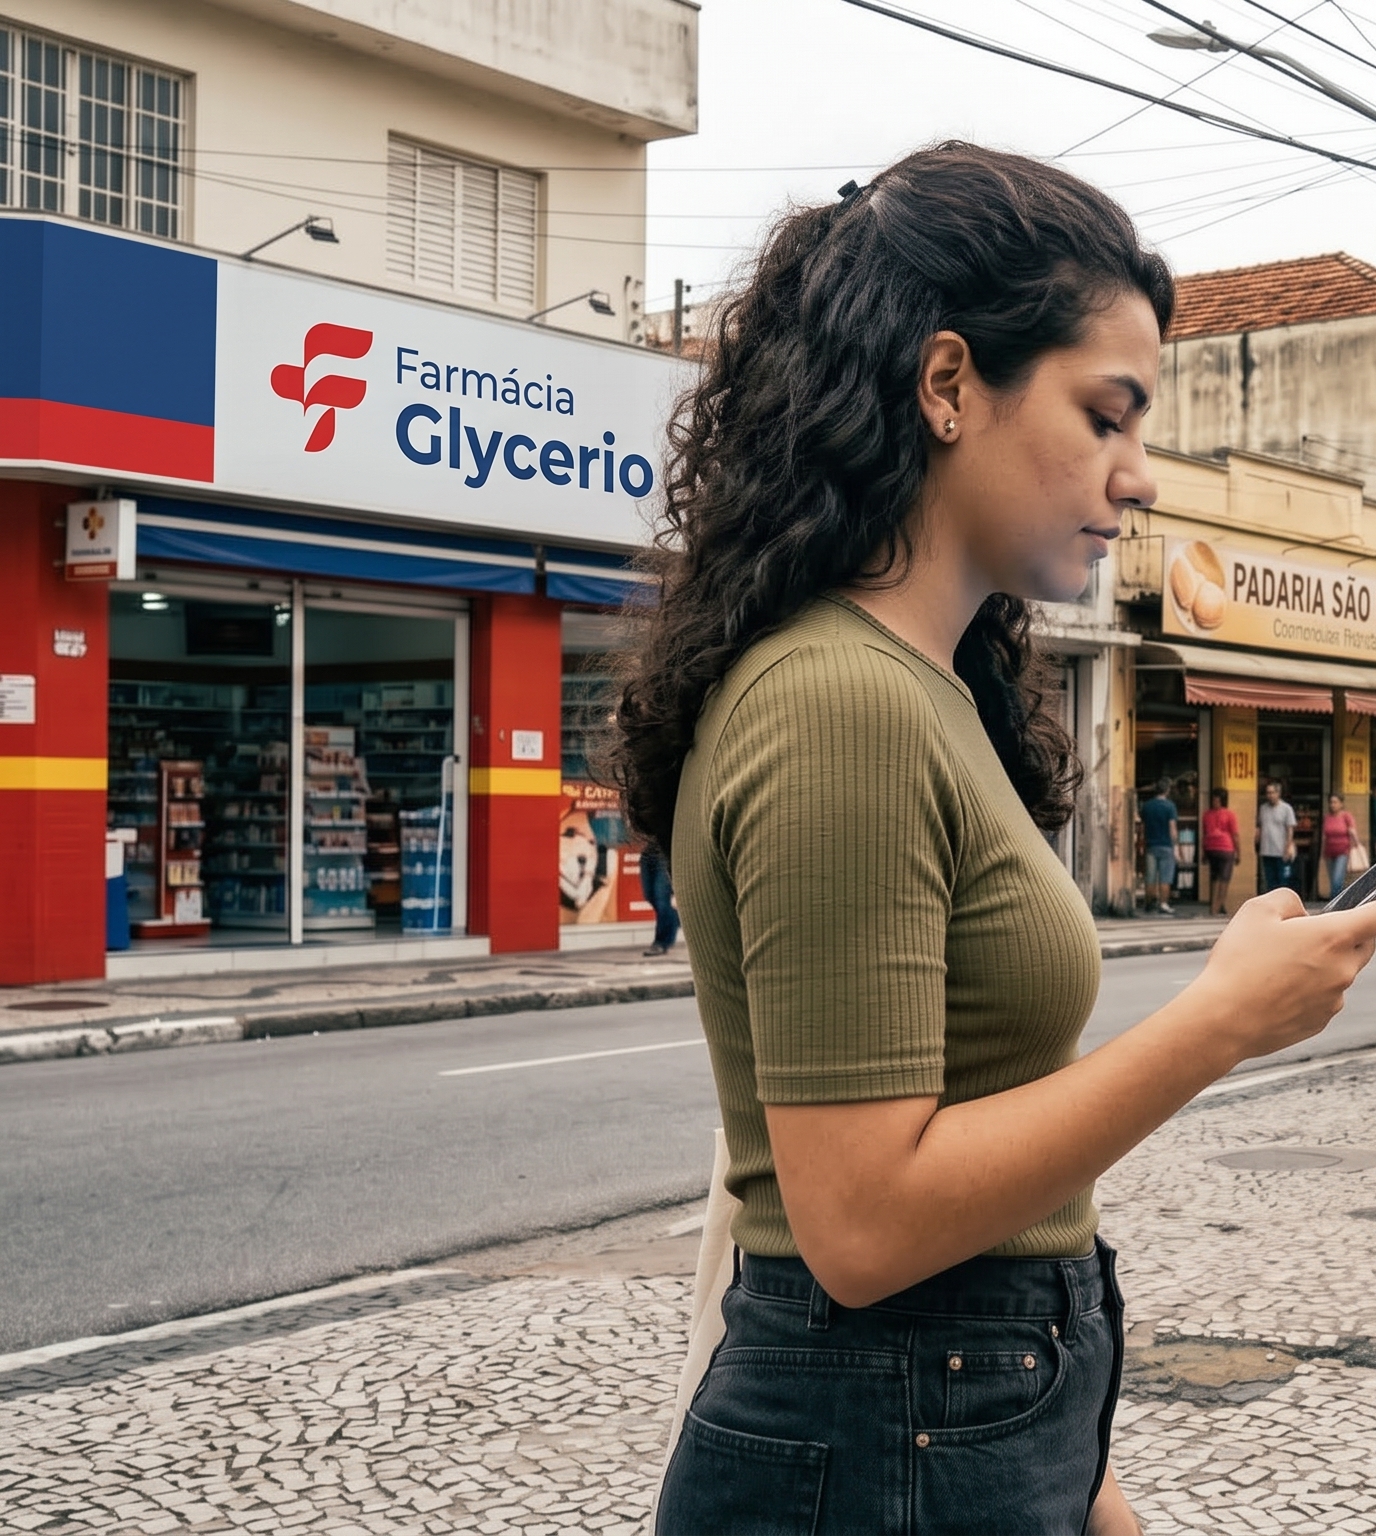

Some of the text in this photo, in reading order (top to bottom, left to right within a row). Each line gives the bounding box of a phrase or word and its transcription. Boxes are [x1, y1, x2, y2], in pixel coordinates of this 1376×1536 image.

[395, 345, 575, 417] Farmácia
[395, 403, 654, 499] Glycerio
[1233, 561, 1326, 617] PADARIA
[1332, 575, 1371, 623] SÃO
